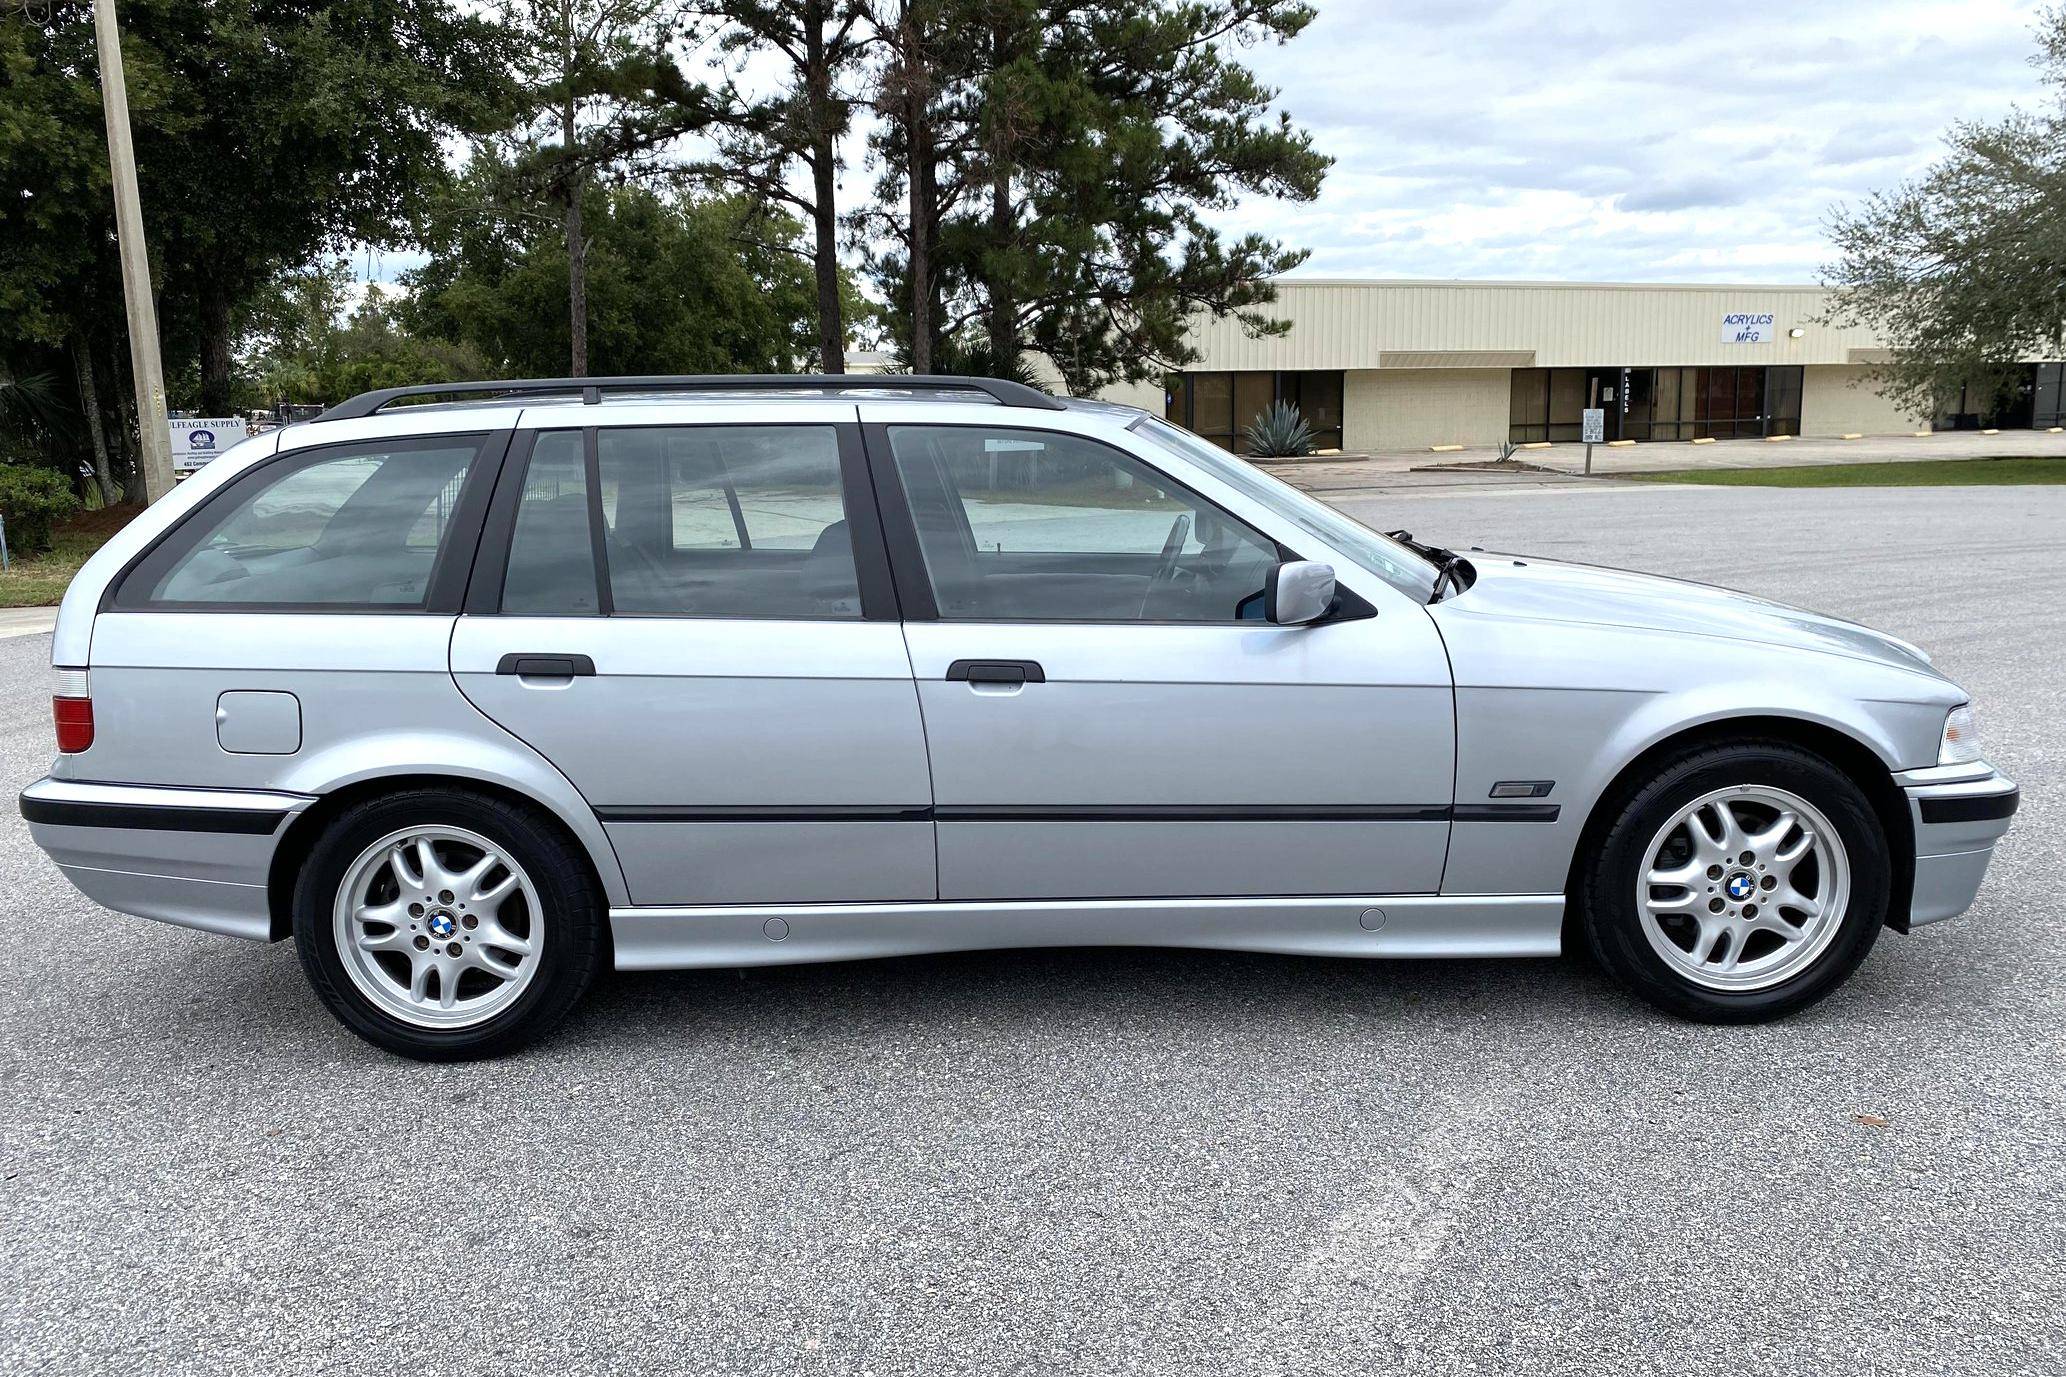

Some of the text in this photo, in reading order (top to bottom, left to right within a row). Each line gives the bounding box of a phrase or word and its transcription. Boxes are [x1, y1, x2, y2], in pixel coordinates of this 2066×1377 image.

[1723, 314, 1774, 325] ACRYLICS
[1735, 331, 1760, 342] MFG
[210, 420, 240, 428] SUPPLY
